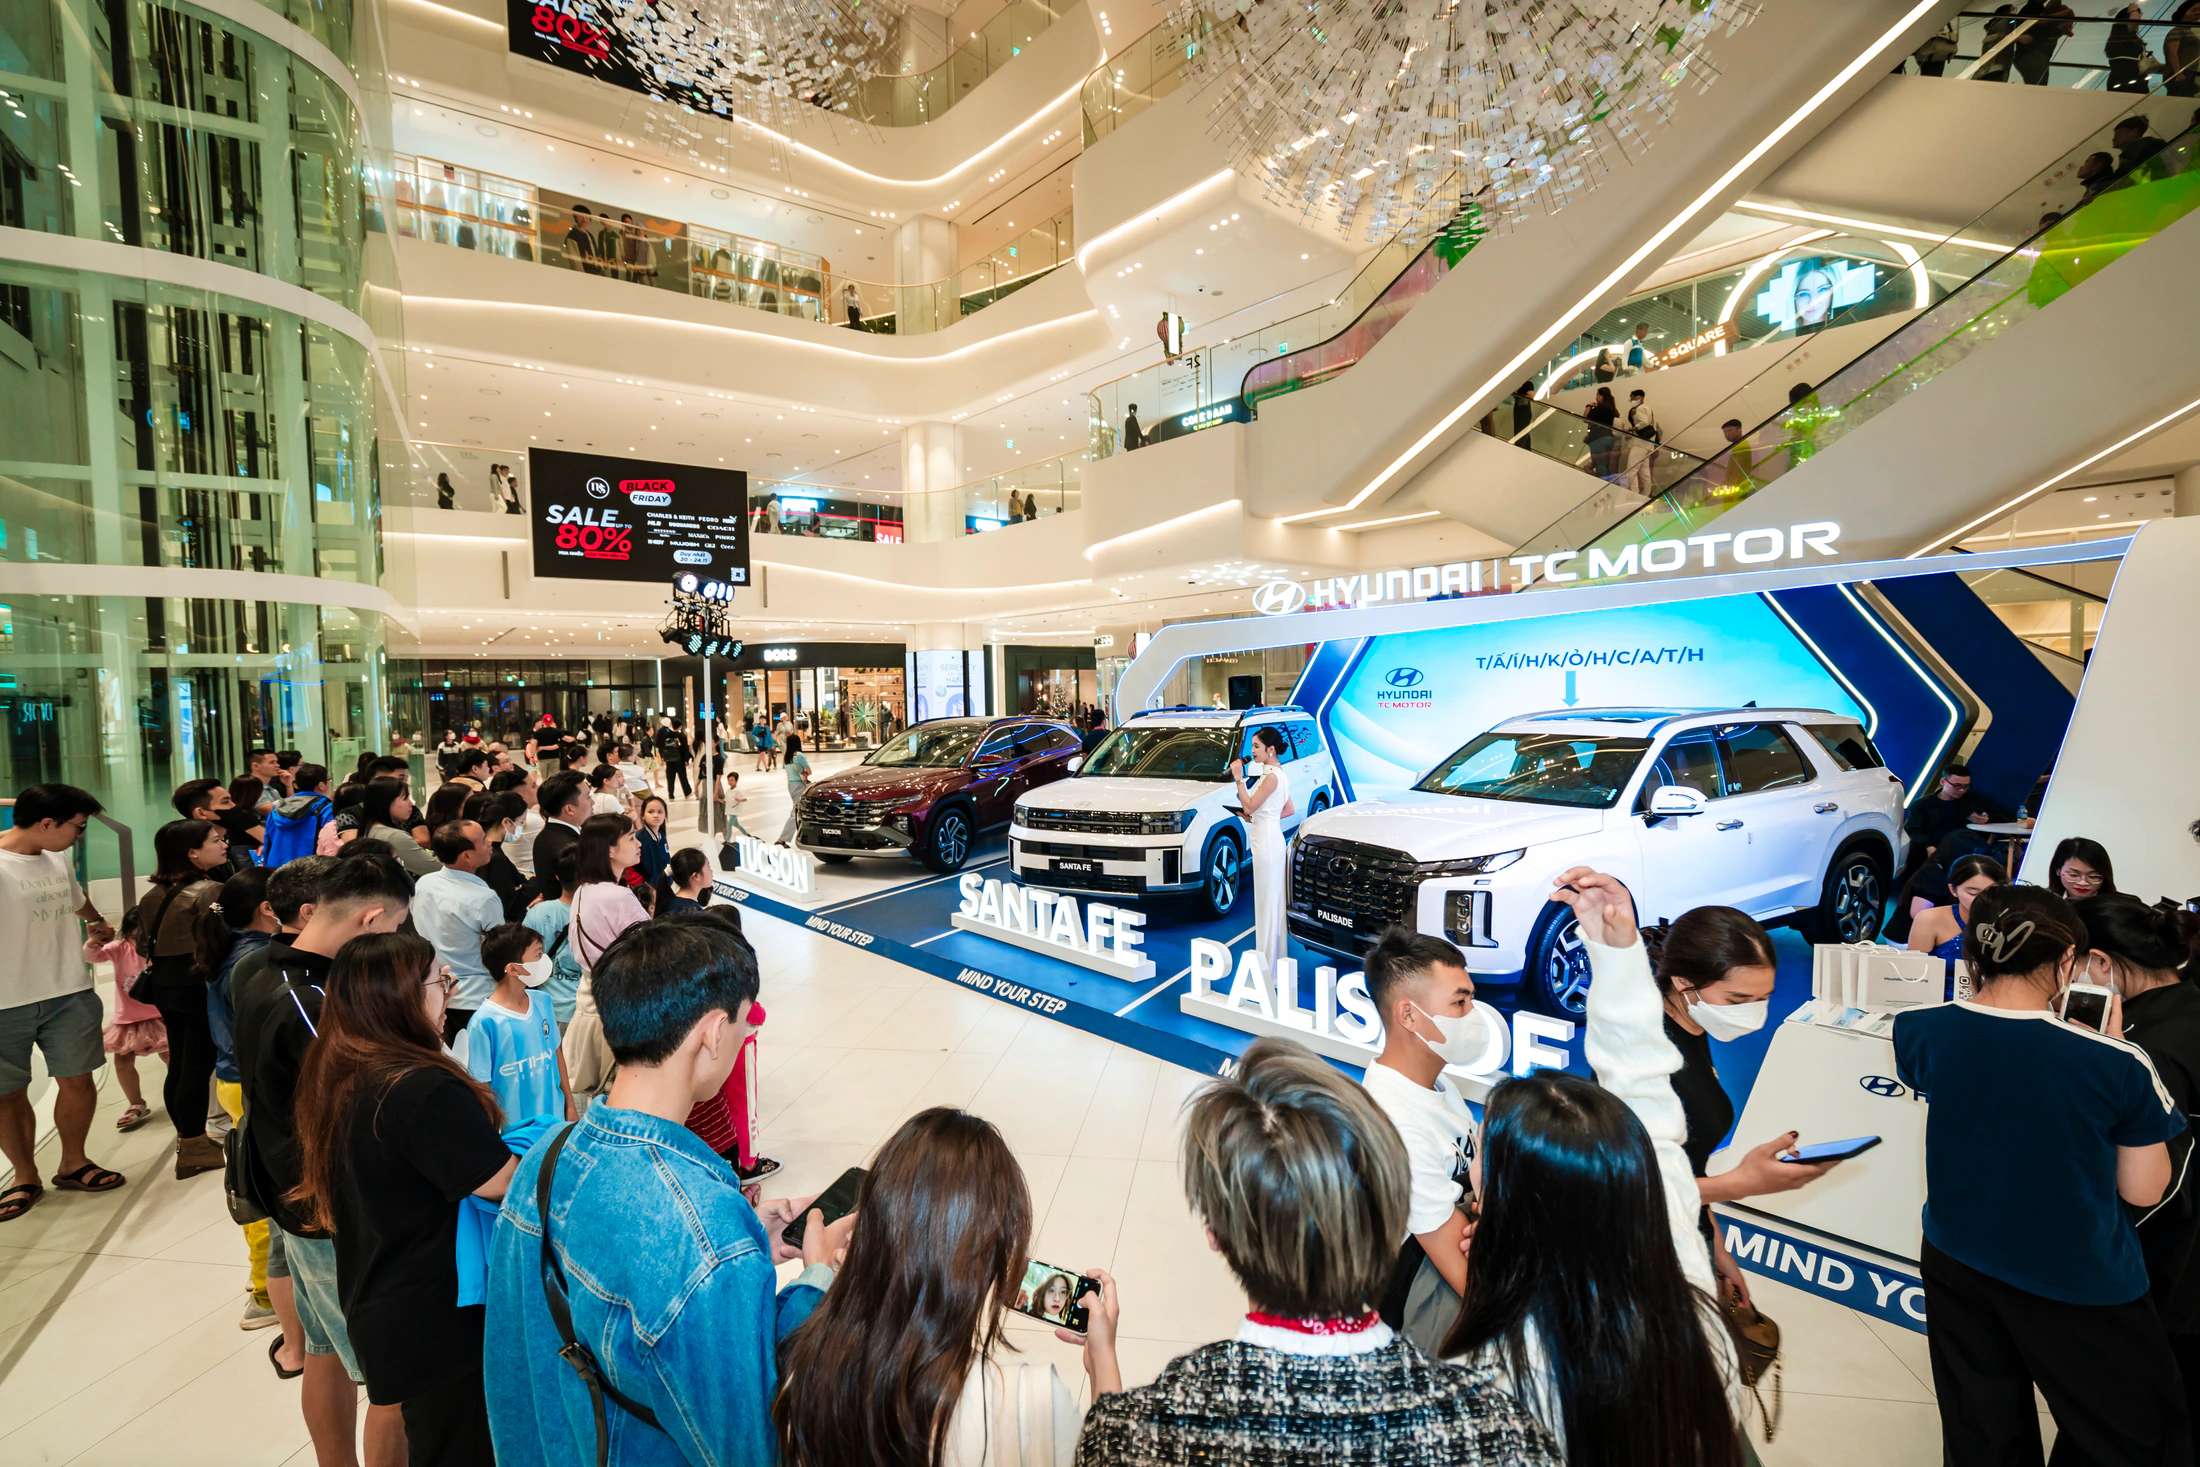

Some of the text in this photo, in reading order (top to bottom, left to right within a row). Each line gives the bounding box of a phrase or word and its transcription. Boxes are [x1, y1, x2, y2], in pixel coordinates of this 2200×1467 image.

[1668, 325, 1726, 359] SQUARE
[626, 482, 668, 491] BLACK
[632, 495, 668, 503] FRIDAY
[545, 504, 619, 528] SALE
[555, 524, 632, 553] 80%
[1314, 521, 1842, 607] HYUNDAI TC MOTOR
[763, 648, 797, 662] BOSS
[940, 663, 976, 672] SERENY
[1377, 690, 1432, 700] HYUNDAI
[736, 835, 814, 893] TUCSON
[1059, 862, 1092, 871] SANTA FE
[20, 876, 68, 891] Don't as
[716, 884, 735, 897] YOUR
[732, 890, 750, 901] STEP
[36, 888, 71, 904] about
[959, 873, 1147, 966] SANTA FE
[1317, 909, 1353, 929] PALISADE
[805, 916, 874, 946] MIND YOUR STEP
[957, 968, 1067, 1015] MIND YOUR STEP
[1190, 937, 1575, 1077] PALISE
[1724, 1224, 1928, 1323] MIND YO
